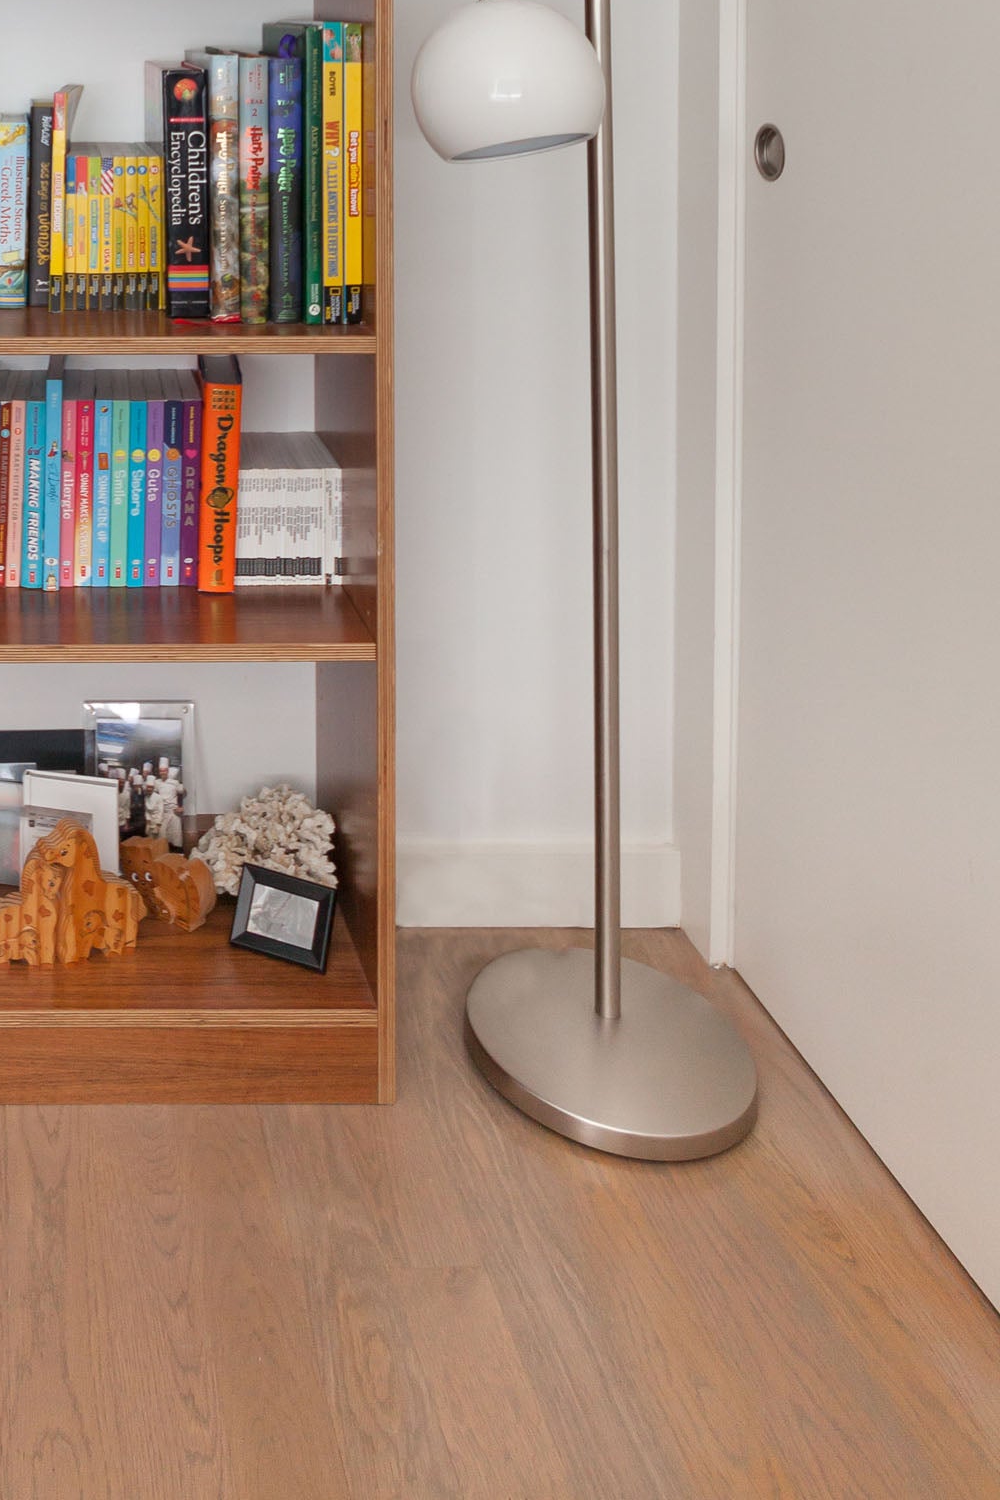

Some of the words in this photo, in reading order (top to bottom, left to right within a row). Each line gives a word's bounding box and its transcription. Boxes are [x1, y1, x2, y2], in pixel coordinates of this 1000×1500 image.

[328, 71, 336, 96] BOYER
[246, 125, 262, 155] Harry
[278, 128, 296, 158] Harry
[325, 121, 340, 156] WHY?
[348, 148, 358, 163] you
[351, 131, 359, 146] Bet
[0, 167, 11, 203] Greek
[15, 156, 25, 206] Illustrated
[168, 131, 185, 225] Encyclopedia
[187, 131, 205, 225] Children's
[247, 157, 264, 191] Potter
[277, 160, 297, 193] Potter
[351, 164, 359, 187] didn't
[327, 191, 338, 224] ANSWERS
[350, 188, 359, 215] know!
[15, 208, 24, 242] Stories
[37, 213, 49, 265] WONDER
[327, 225, 338, 233] TO
[327, 235, 338, 277] EVERYTHING
[209, 414, 234, 486] Dragon
[28, 458, 40, 509] MAKING
[79, 473, 89, 496] SUNNY
[99, 475, 107, 500] SUNNY
[114, 470, 126, 505] Smile
[131, 469, 144, 516] Sisters
[148, 469, 160, 501] Guts
[166, 467, 177, 528] GHOSTS
[185, 467, 195, 526] DRAMA
[79, 498, 89, 522] MAKES
[27, 511, 40, 560] FRIENDS
[98, 530, 106, 542] UP
[207, 510, 230, 565] Hoops
